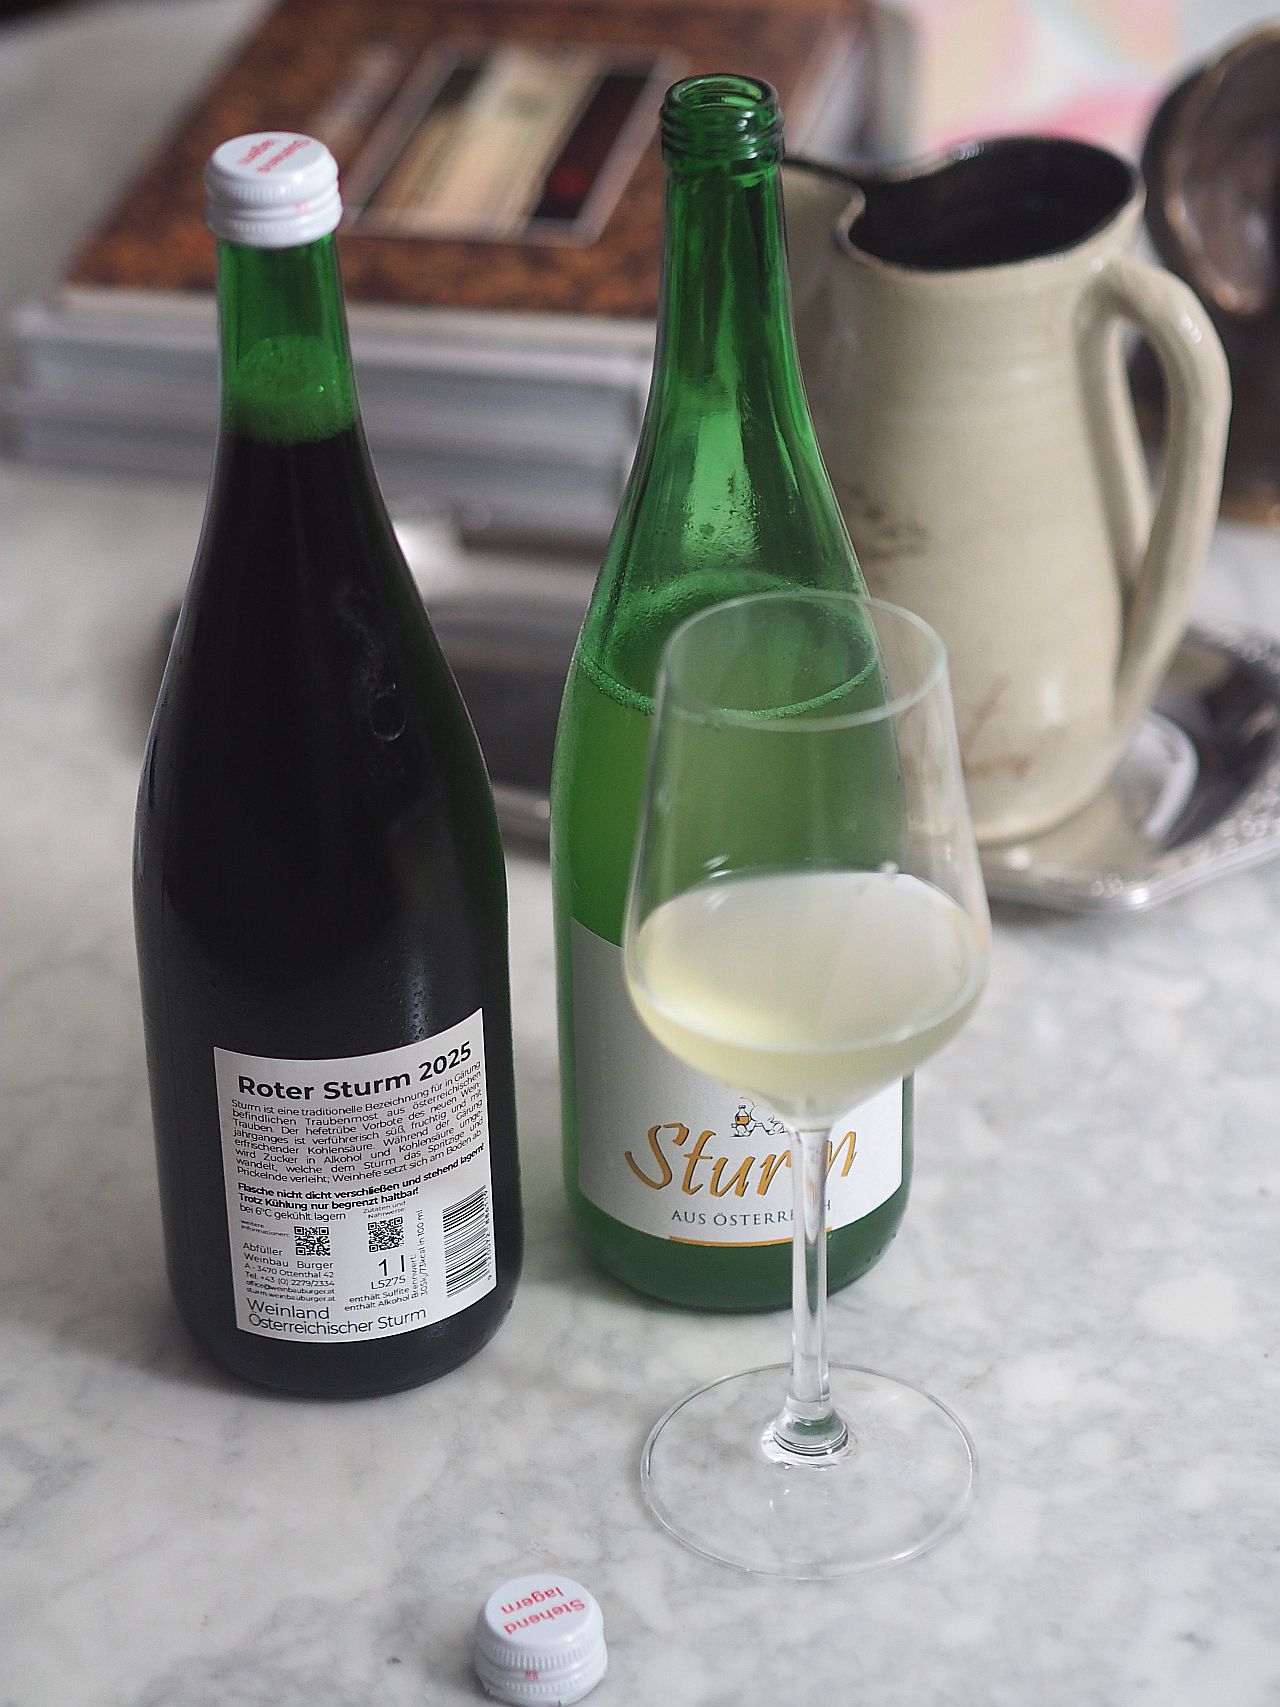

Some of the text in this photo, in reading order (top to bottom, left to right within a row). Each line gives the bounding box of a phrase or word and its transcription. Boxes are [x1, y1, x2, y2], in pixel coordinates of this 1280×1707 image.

[238, 1041, 471, 1100] Roter Sturm 2025
[232, 1061, 481, 1116] Sturm ist eine traditionelle Bezeichnung für in Gärung
[233, 1071, 481, 1126] befindlichen Traubenmost aus österreichischen
[233, 1090, 482, 1145] jahrganges ist verführerisch süß, fruchtig und mit
[235, 1099, 482, 1155] erfrischender Kohlensäure. Während der Gärung
[281, 1126, 299, 1135] Der
[306, 1126, 357, 1135] hefetrübe
[362, 1117, 403, 1131] Vorbote
[409, 1110, 425, 1121] des
[430, 1096, 457, 1113] neuen
[235, 1148, 256, 1159] wird
[264, 1152, 298, 1163] Zucker
[306, 1156, 316, 1164] in
[324, 1152, 362, 1164] Alkohol
[370, 1148, 391, 1159] und
[399, 1127, 454, 1152] Kohlensäure
[236, 1117, 483, 1173] wandelt, welche dem Sturm das Spritzige und
[237, 1165, 288, 1182] Prickelnde
[332, 1170, 382, 1183] Weinhefe
[384, 1164, 407, 1176] setzt
[409, 1158, 427, 1169] sich
[429, 1152, 444, 1161] am
[446, 1135, 471, 1155] Boden
[472, 1129, 482, 1140] ab
[238, 1142, 485, 1200] Flasche nicht dicht verschließen und stehend lagern!
[238, 1187, 419, 1211] Trotz Kühlung nur begrenzt haltbar!
[240, 1203, 254, 1214] bei
[274, 1210, 312, 1221] gekühlt
[314, 1211, 346, 1222] lagern
[416, 1209, 424, 1221] ml
[671, 1200, 831, 1227] AUS ÖSTERRH
[416, 1222, 425, 1237] 100
[243, 1242, 283, 1256] Abfüller
[244, 1252, 334, 1270] Weinbau Burger
[245, 1271, 258, 1280] Tel.
[260, 1275, 275, 1283] +43
[278, 1277, 289, 1286] (0)
[257, 1265, 277, 1275] 3470
[279, 1269, 321, 1278] Ottenthal
[378, 1258, 388, 1277] 1
[378, 1295, 411, 1308] Alkohol
[383, 1287, 410, 1299] Sulfite
[246, 1297, 330, 1320] Weinland
[249, 1309, 426, 1335] Österreichischer Sturm
[501, 1586, 564, 1614] lagern
[503, 1599, 585, 1635] Stehend
